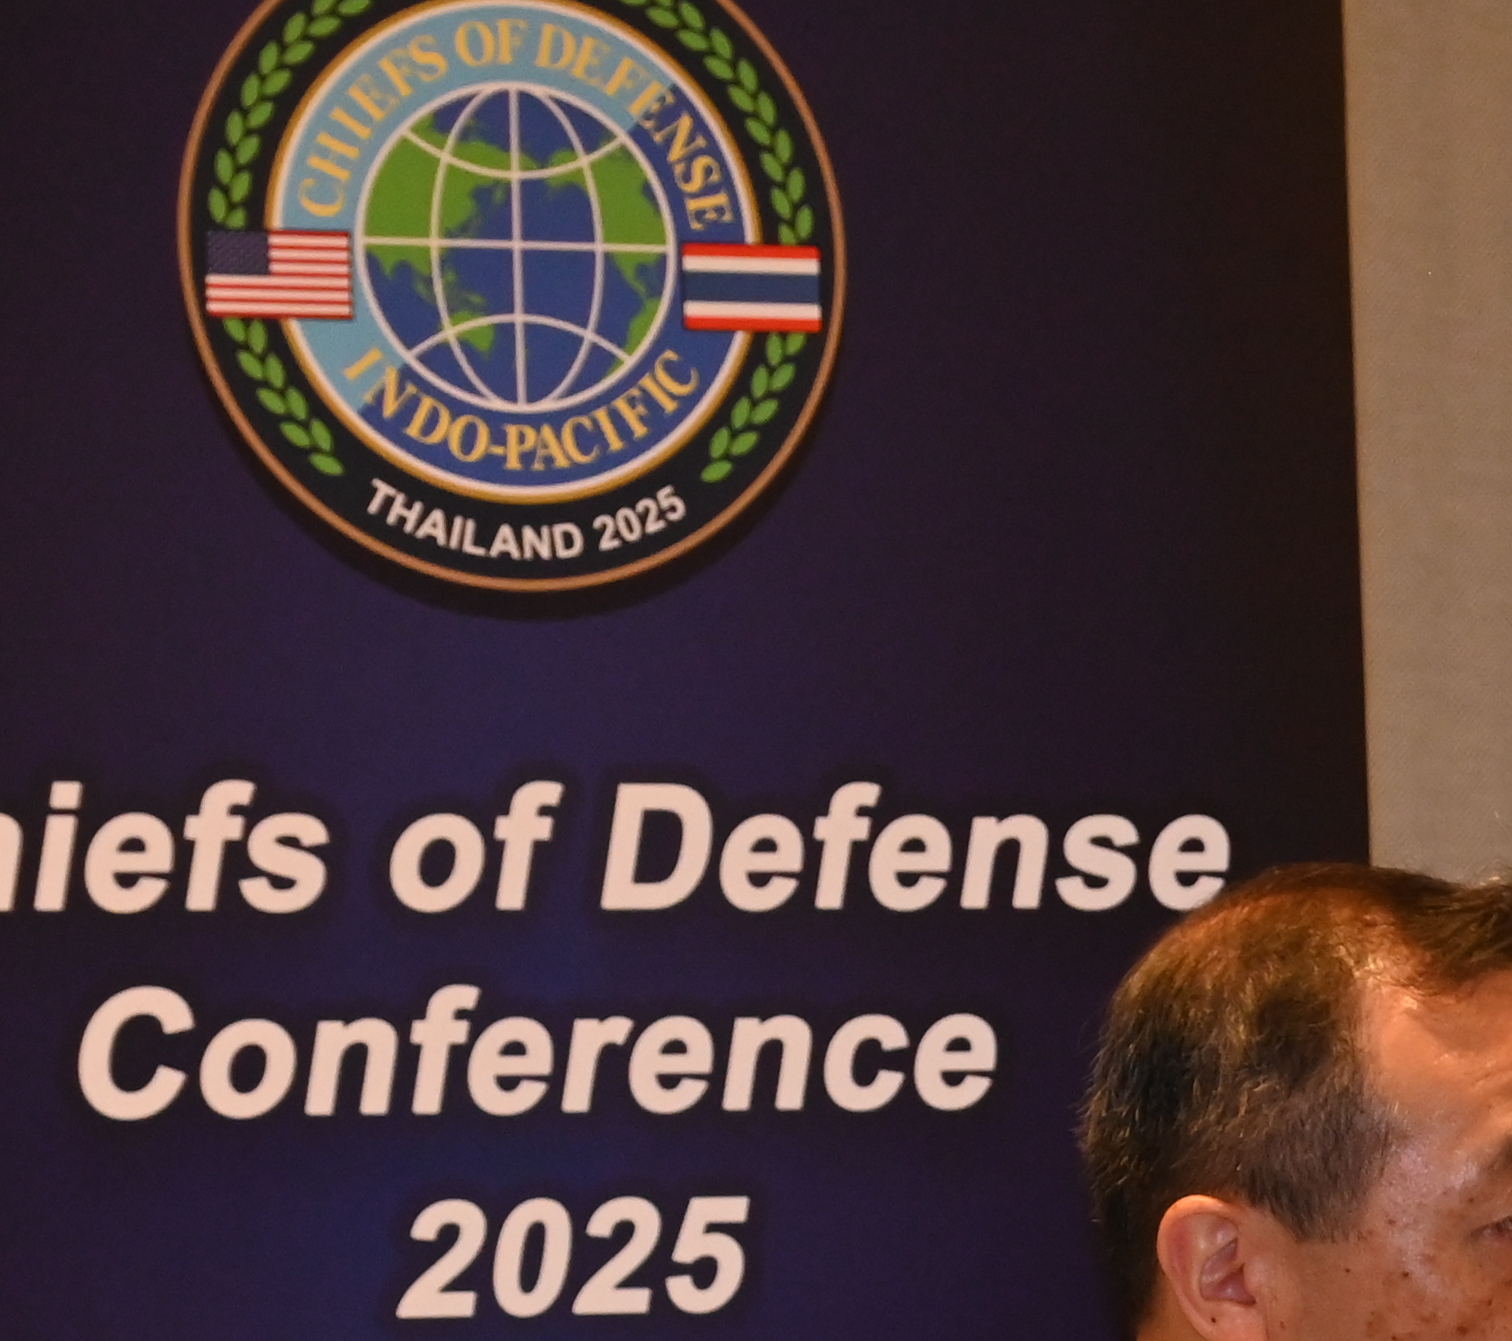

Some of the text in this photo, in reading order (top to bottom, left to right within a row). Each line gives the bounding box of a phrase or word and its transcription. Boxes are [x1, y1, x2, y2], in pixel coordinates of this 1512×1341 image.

[300, 18, 735, 231] CHIEFS OF DEFENSE
[343, 347, 699, 471] INDO-PACIFIC
[366, 478, 688, 562] THAILAND 2025
[389, 780, 564, 913] of
[600, 782, 1232, 912] Defense
[77, 985, 999, 1120] Conference
[395, 1196, 750, 1319] 2025
